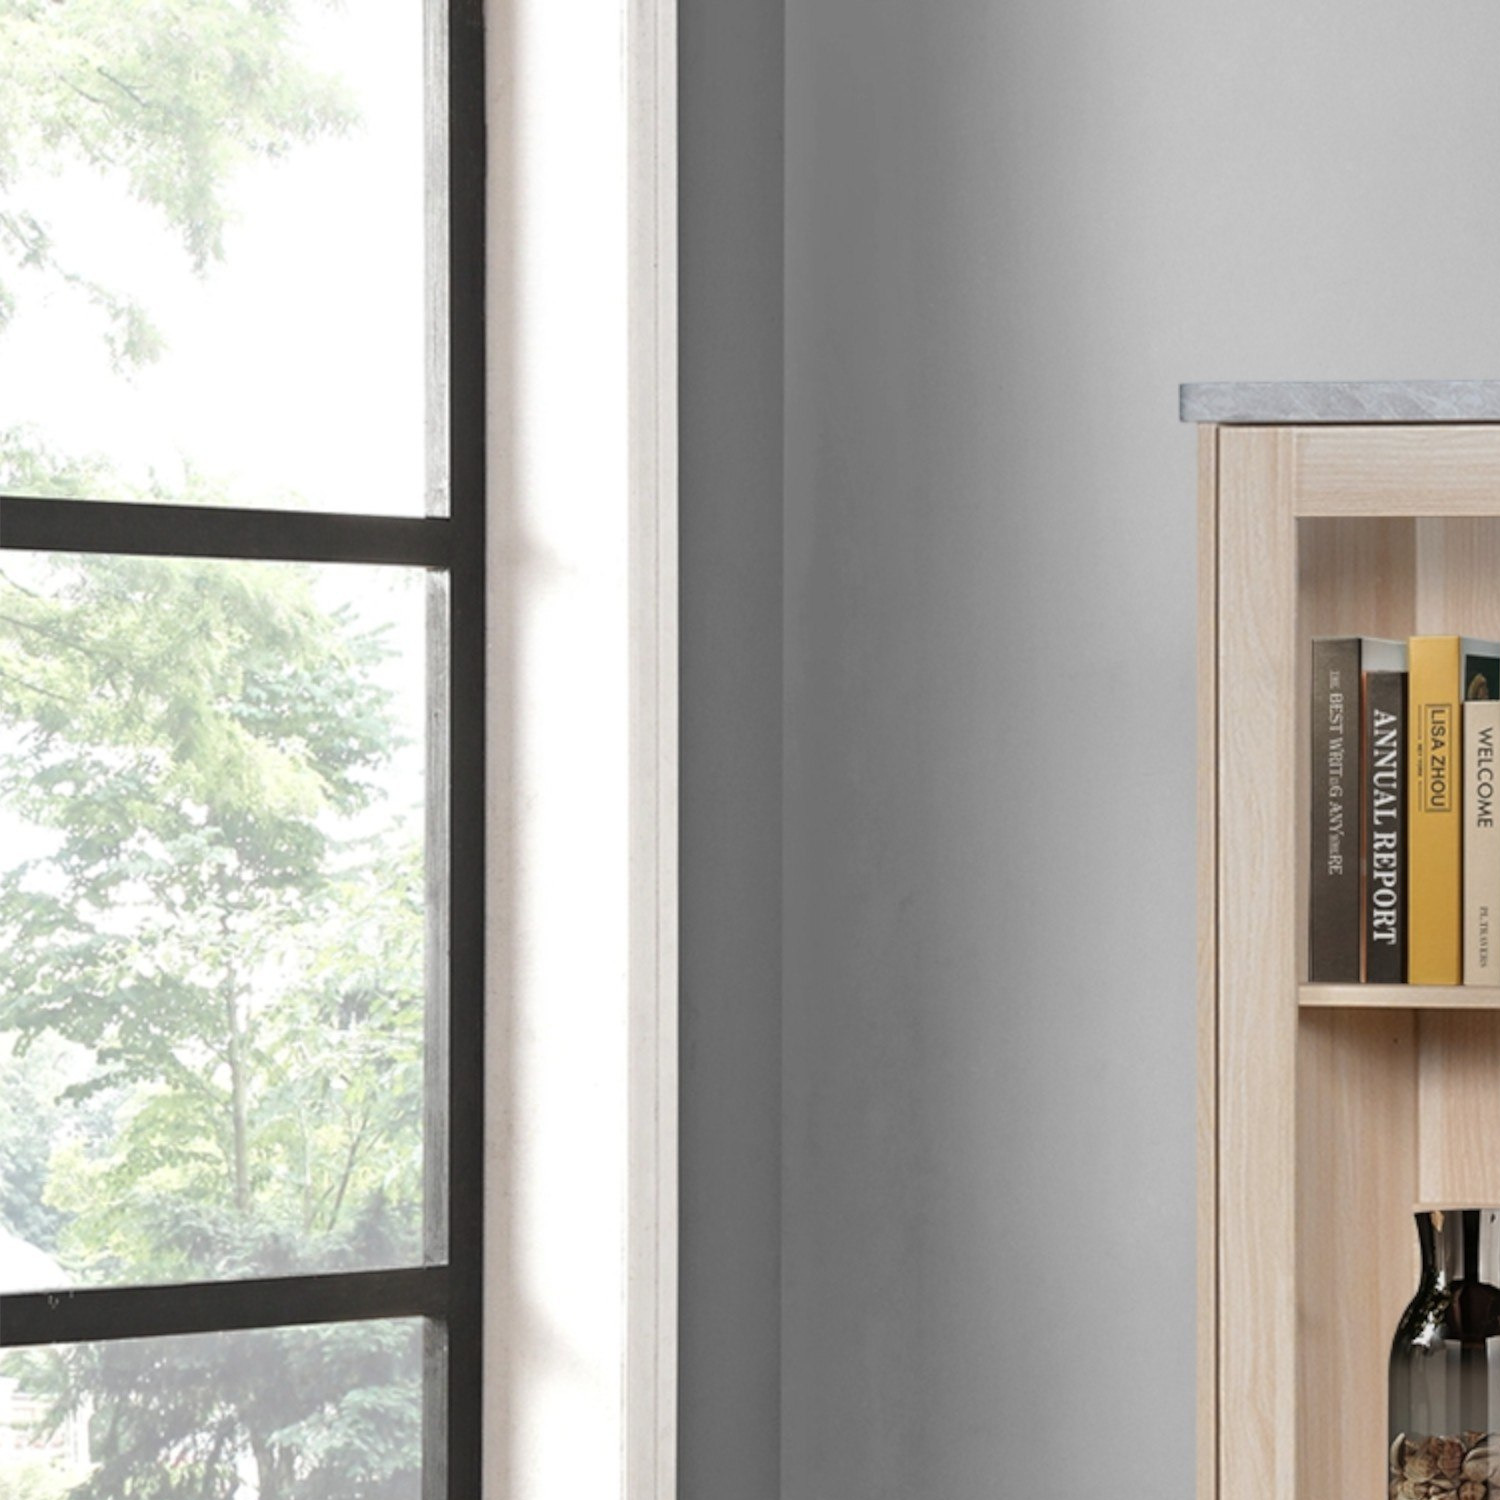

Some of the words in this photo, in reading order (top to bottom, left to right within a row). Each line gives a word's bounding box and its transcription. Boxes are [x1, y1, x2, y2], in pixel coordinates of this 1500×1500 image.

[1329, 693, 1343, 734] BEST
[1431, 709, 1445, 750] LISA
[1372, 709, 1397, 826] ANNUAL
[1431, 755, 1445, 807] ZHOU
[1478, 728, 1493, 828] WELCOME
[1372, 831, 1397, 945] REPORT
